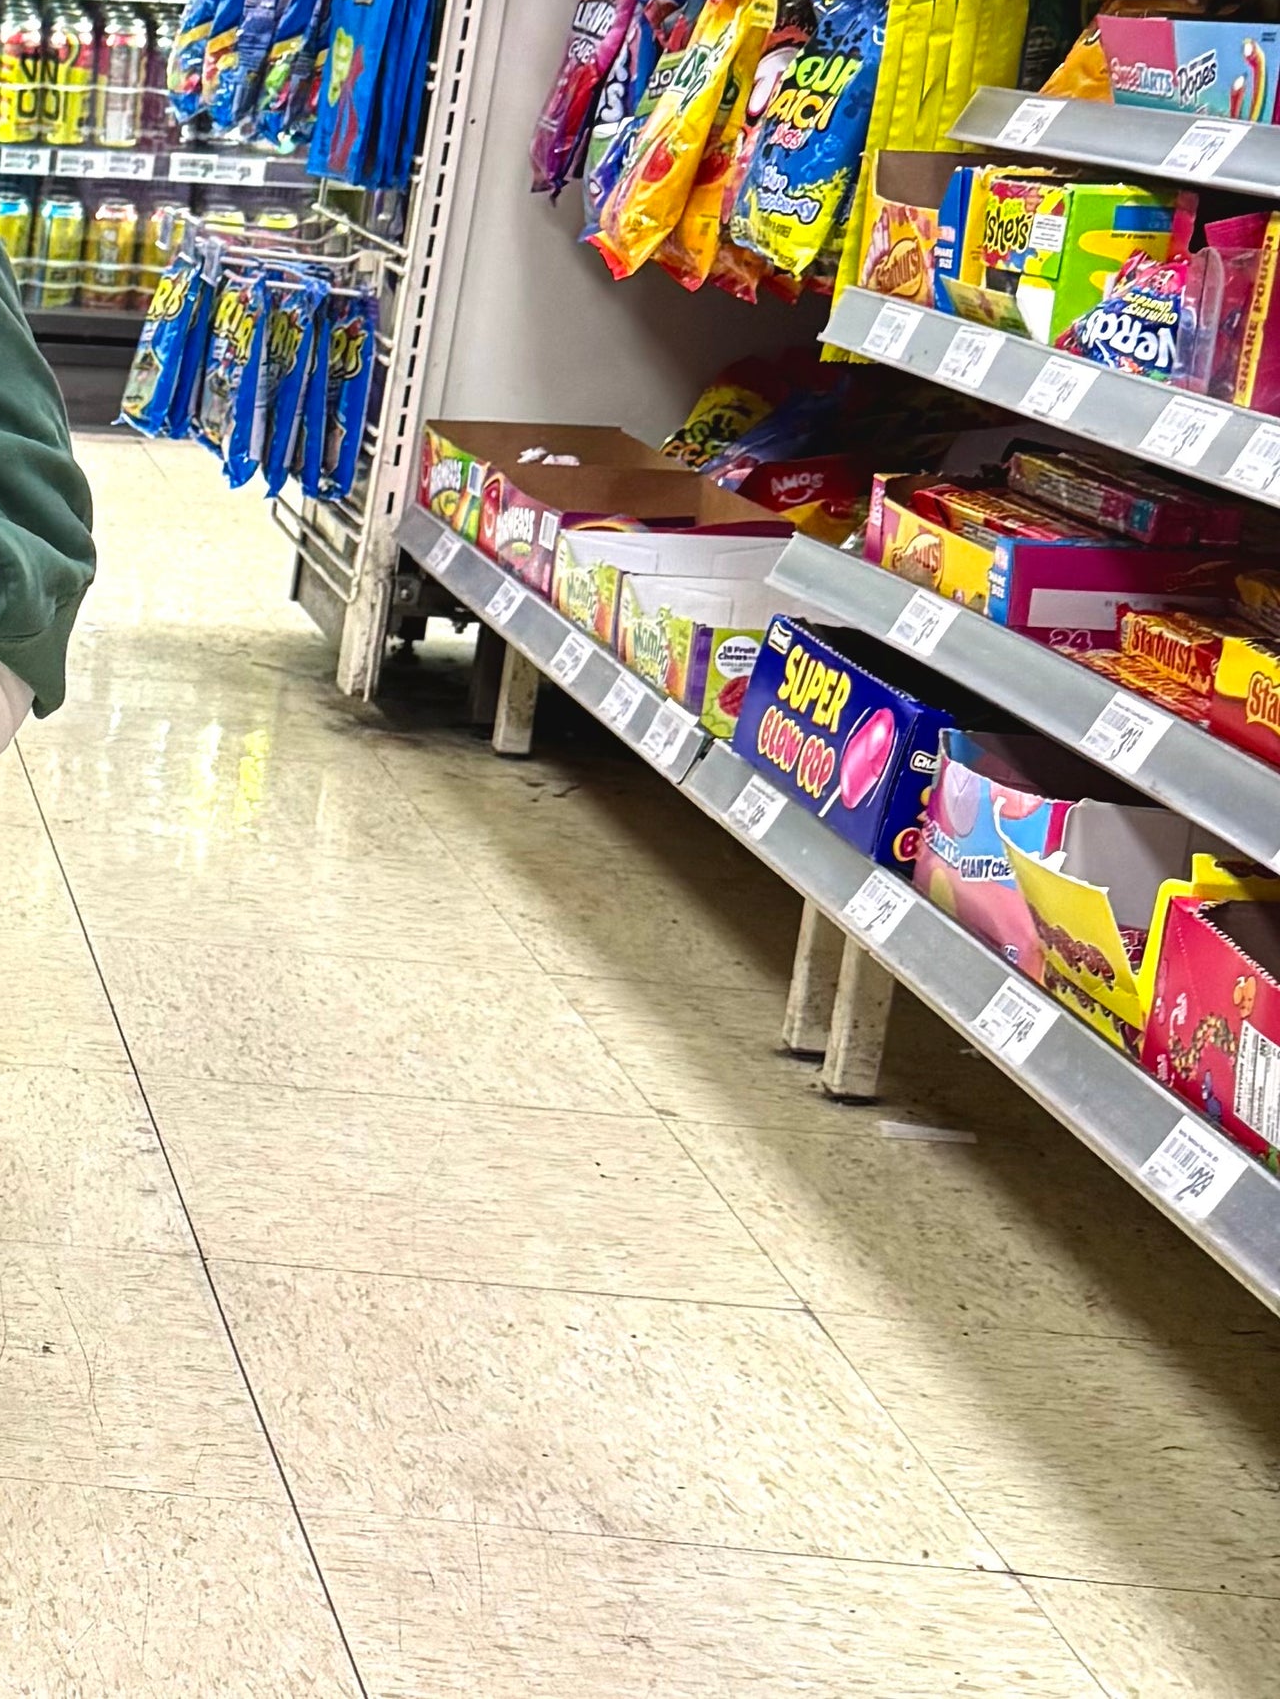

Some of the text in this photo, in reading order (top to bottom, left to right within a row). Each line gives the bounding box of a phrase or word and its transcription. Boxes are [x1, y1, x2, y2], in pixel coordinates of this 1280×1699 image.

[1237, 320, 1263, 398] SHARE
[770, 471, 826, 496] AMOS
[777, 643, 854, 735] SUPER
[756, 706, 837, 800] BLOW POP
[961, 856, 992, 883] GIANT
